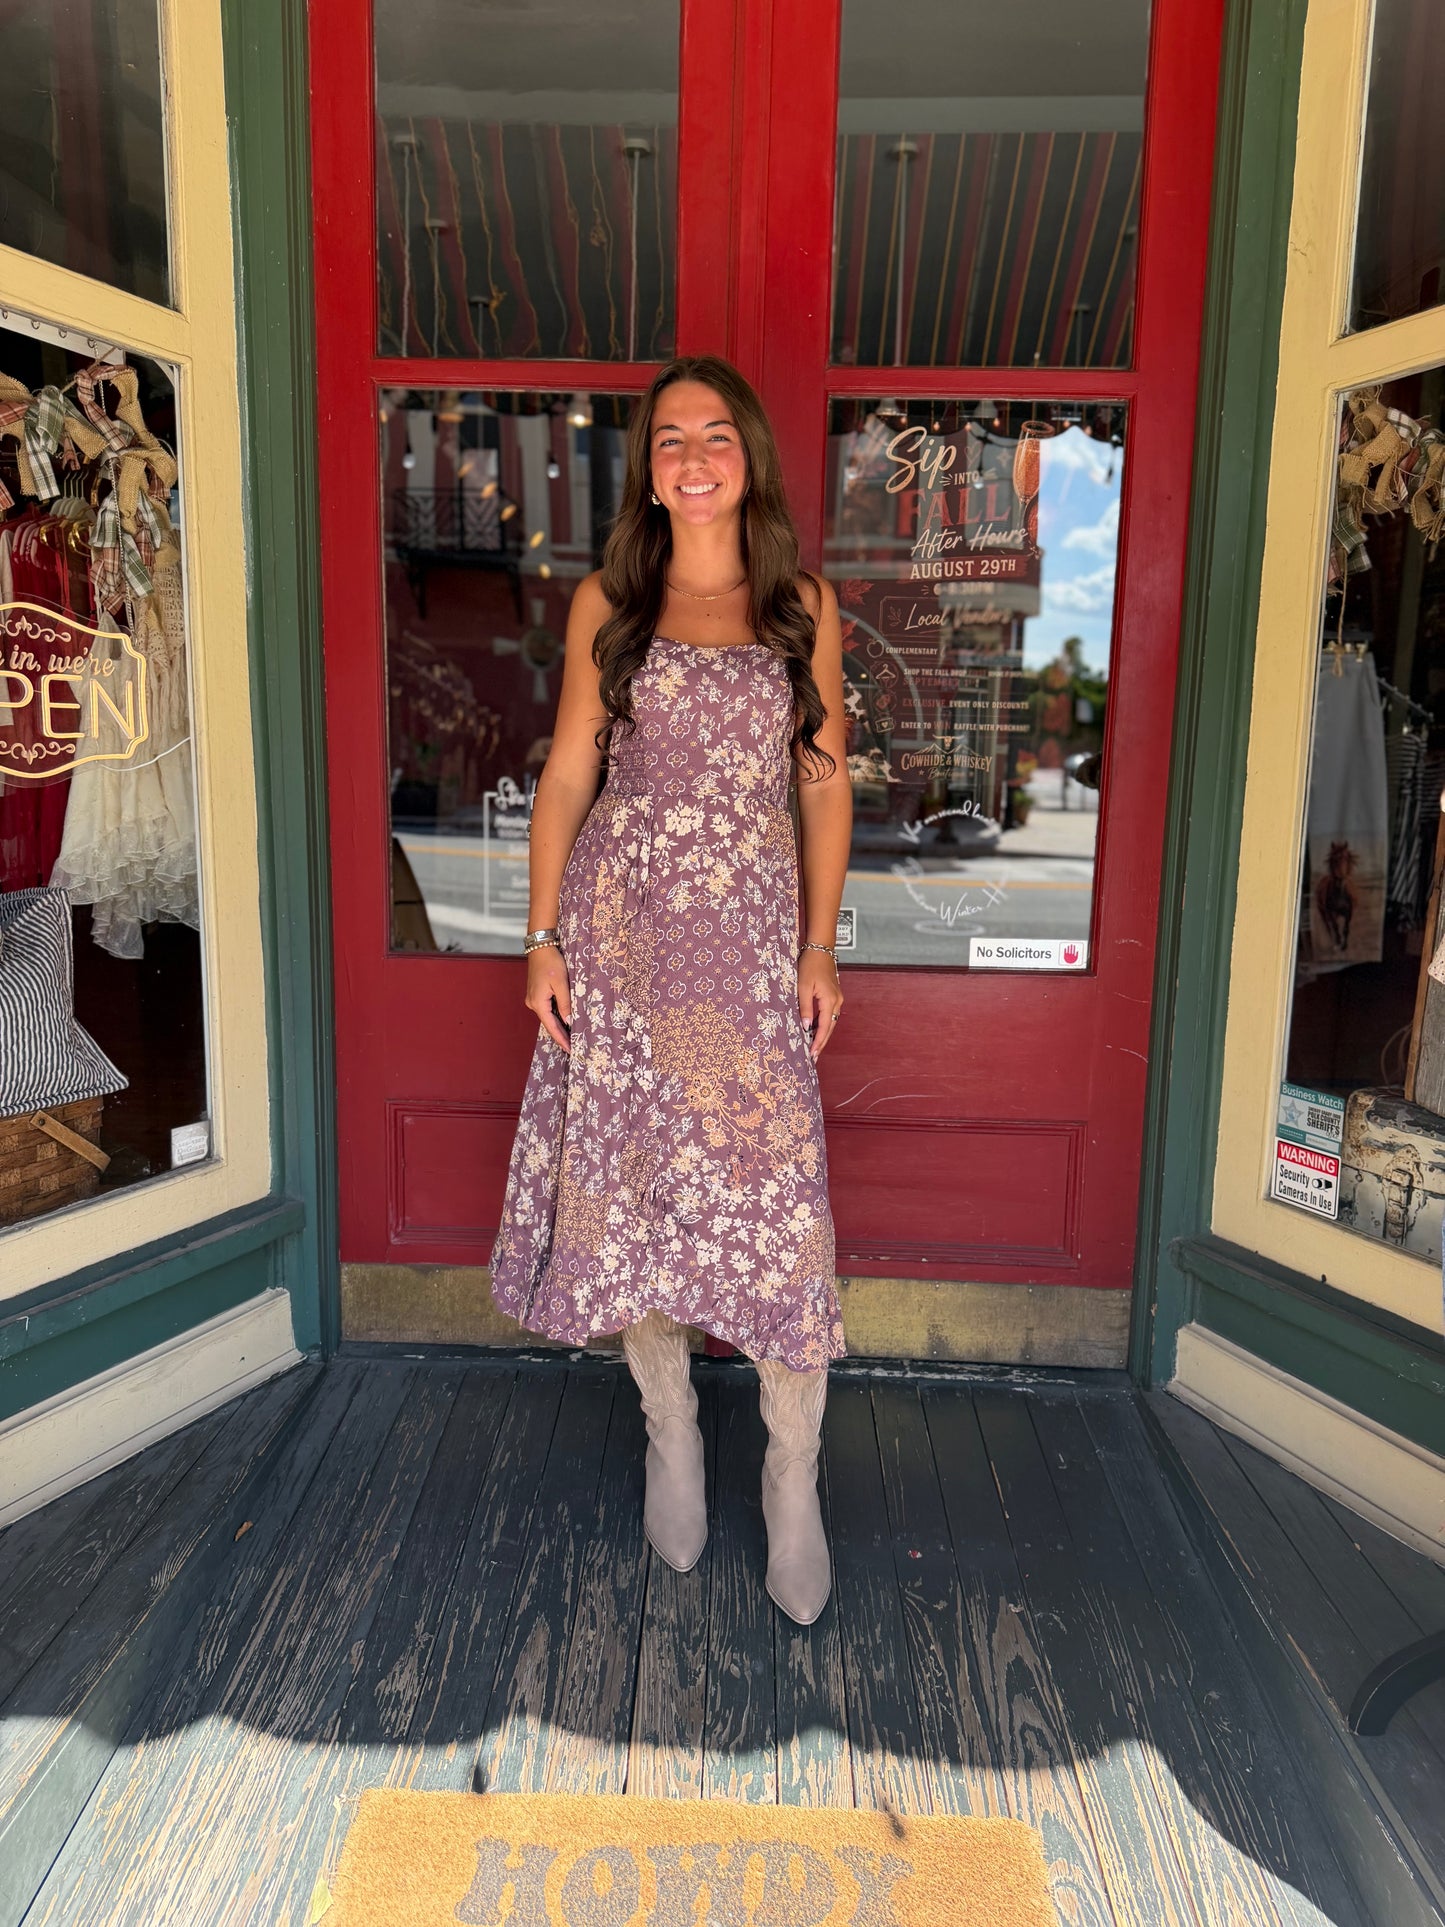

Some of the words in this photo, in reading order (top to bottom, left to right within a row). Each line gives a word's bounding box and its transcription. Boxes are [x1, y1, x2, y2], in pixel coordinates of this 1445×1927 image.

[885, 426, 957, 493] Sip
[954, 472, 979, 485] INTO
[896, 483, 1009, 536] FALL
[911, 528, 963, 558] After
[970, 522, 1028, 551] Hours
[910, 560, 974, 579] AUGUST
[980, 559, 1016, 575] 29TH
[904, 603, 951, 631] Local
[9, 644, 41, 672] in,
[47, 647, 115, 677] we're
[885, 647, 938, 655] COMPLEMENTARY
[904, 668, 920, 676] SHOP
[921, 668, 933, 676] THE
[0, 670, 136, 739] PEN
[901, 753, 945, 770] COWHIDE
[946, 755, 952, 766] &
[953, 754, 992, 772] WHISKEY
[940, 892, 983, 927] Winter
[976, 946, 993, 958] No
[996, 946, 1052, 960] Solicitors
[1282, 1084, 1316, 1102] Business
[1318, 1094, 1344, 1110] Watch
[1280, 1143, 1336, 1173] WARNING
[1279, 1165, 1311, 1188] Security
[1278, 1180, 1308, 1202] Cameras
[1310, 1189, 1317, 1203] In
[1319, 1193, 1332, 1211] Use
[453, 1833, 914, 1927] HOWDY
